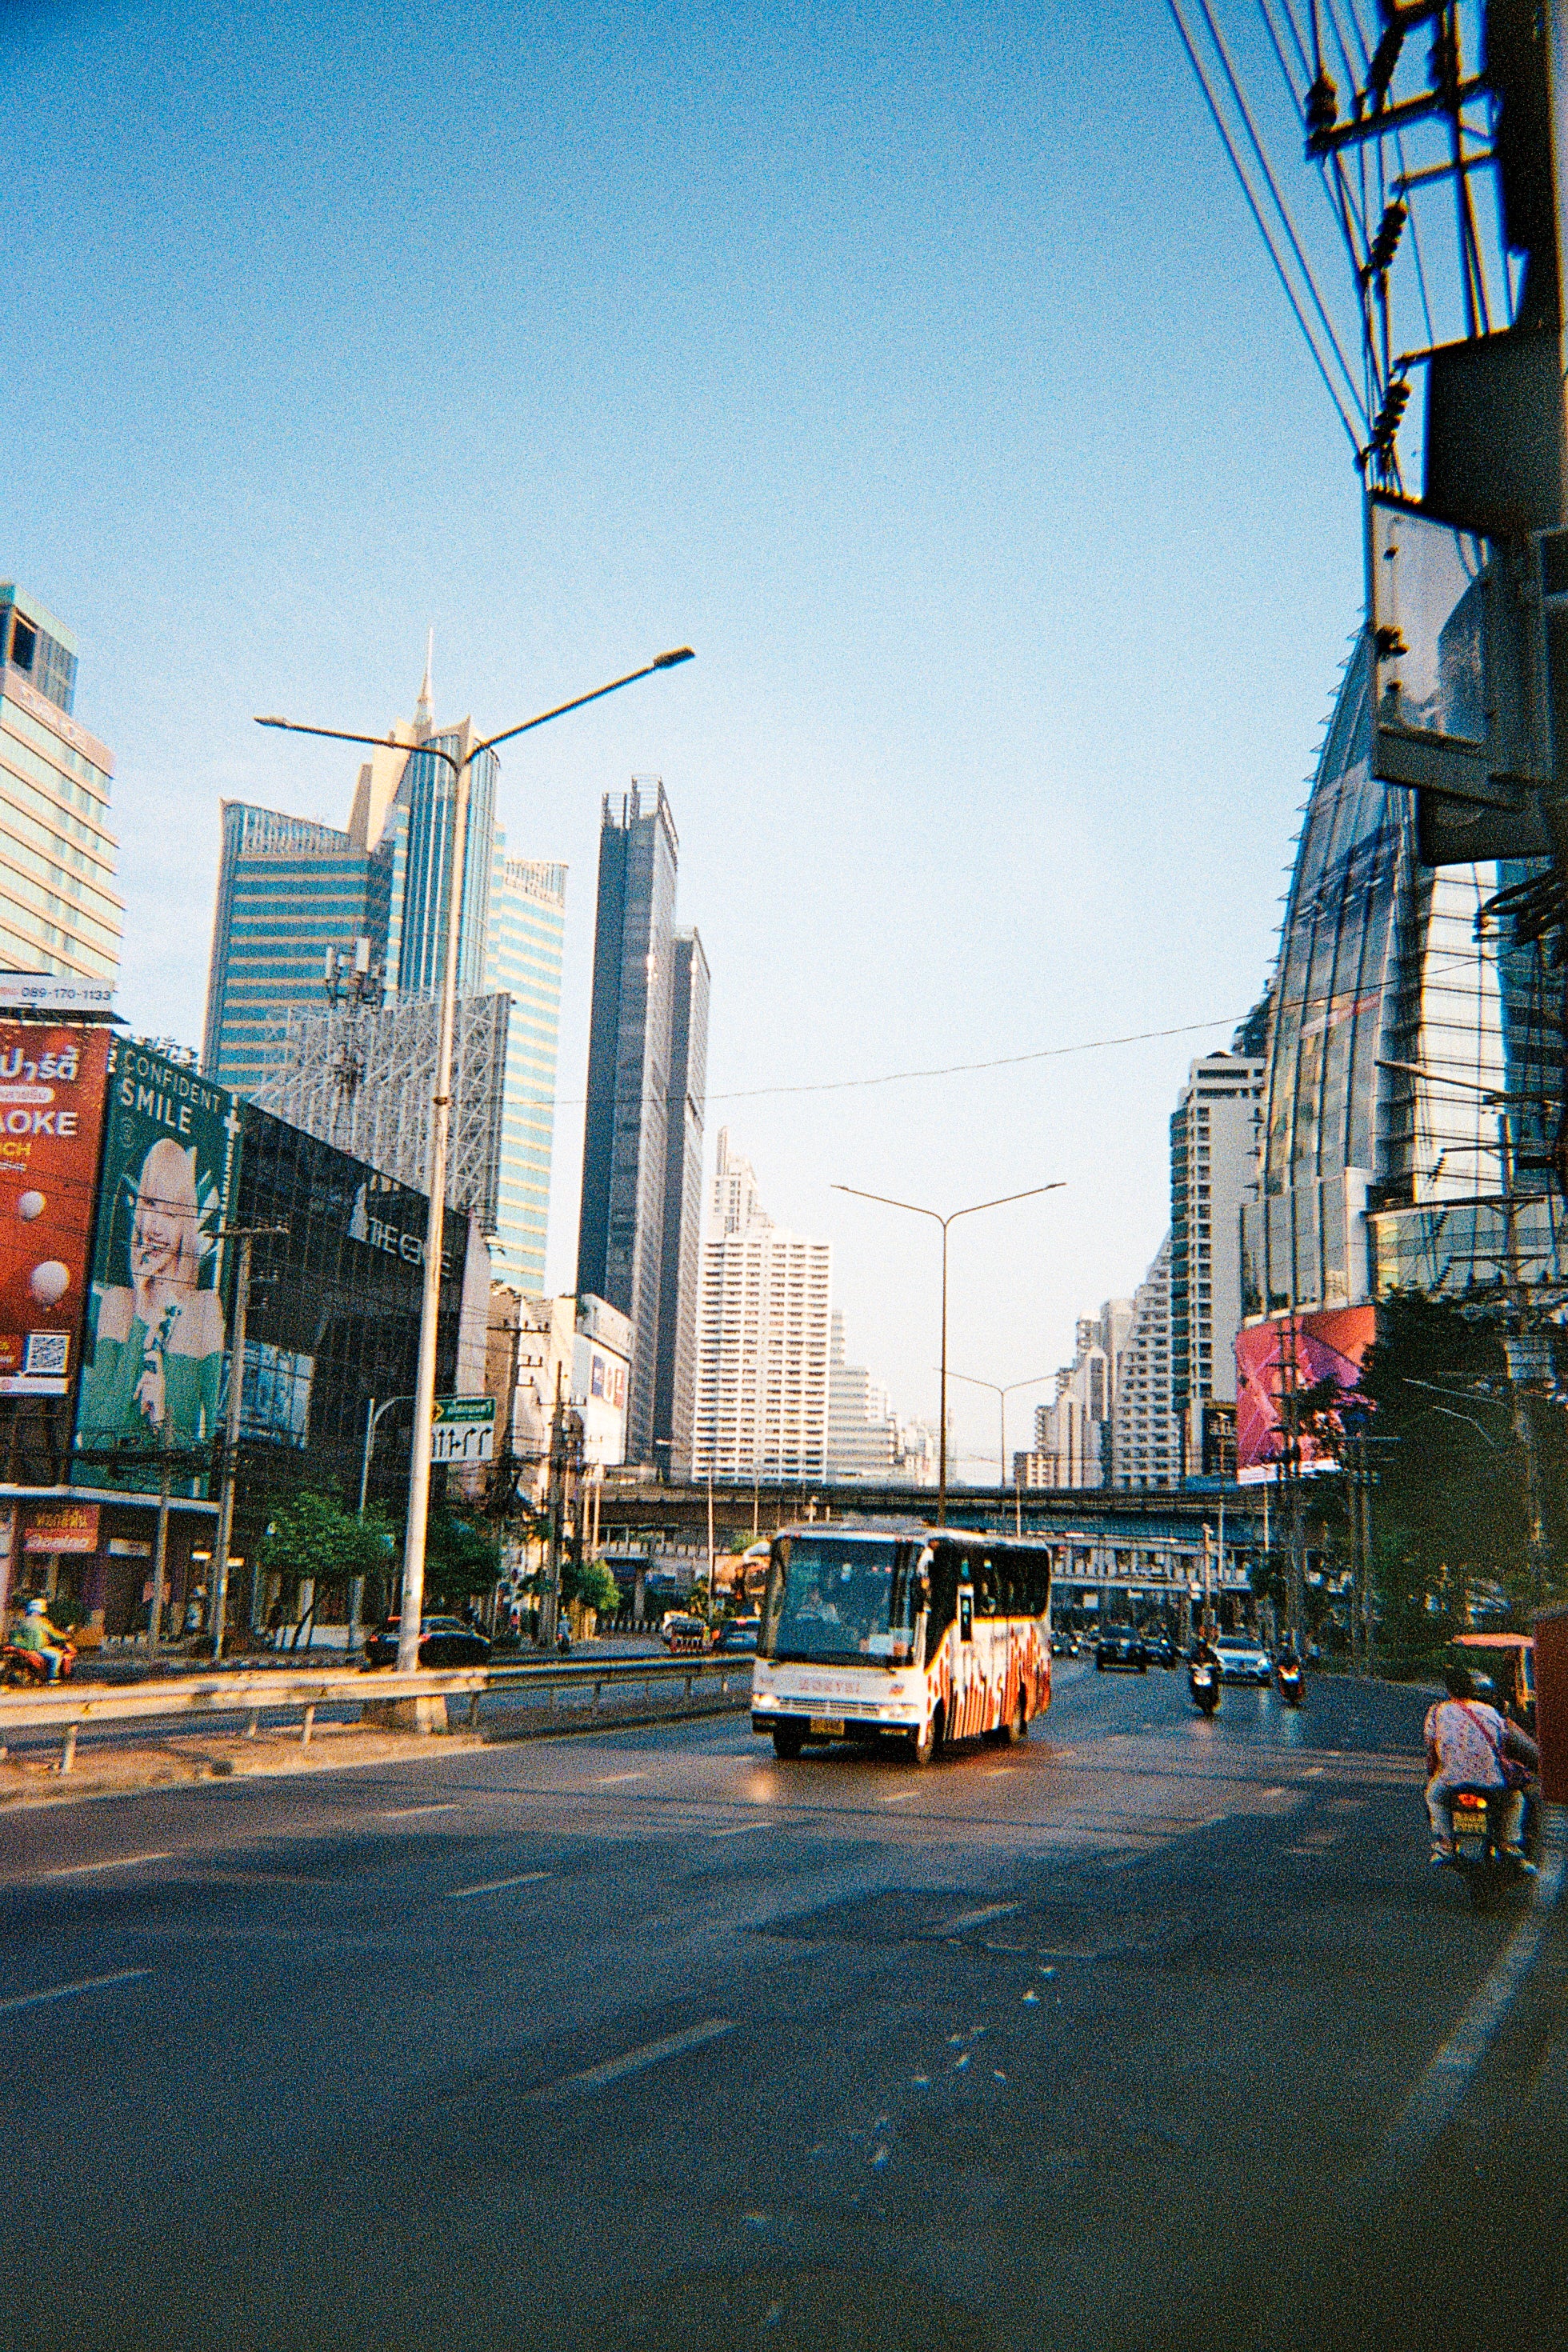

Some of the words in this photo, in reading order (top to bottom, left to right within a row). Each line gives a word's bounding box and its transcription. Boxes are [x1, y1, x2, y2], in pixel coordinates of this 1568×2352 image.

[21, 986, 111, 1001] 089-170-1133
[123, 1050, 221, 1113] CONFIDENT
[121, 1078, 193, 1134] SMILE
[0, 1142, 31, 1156] CH
